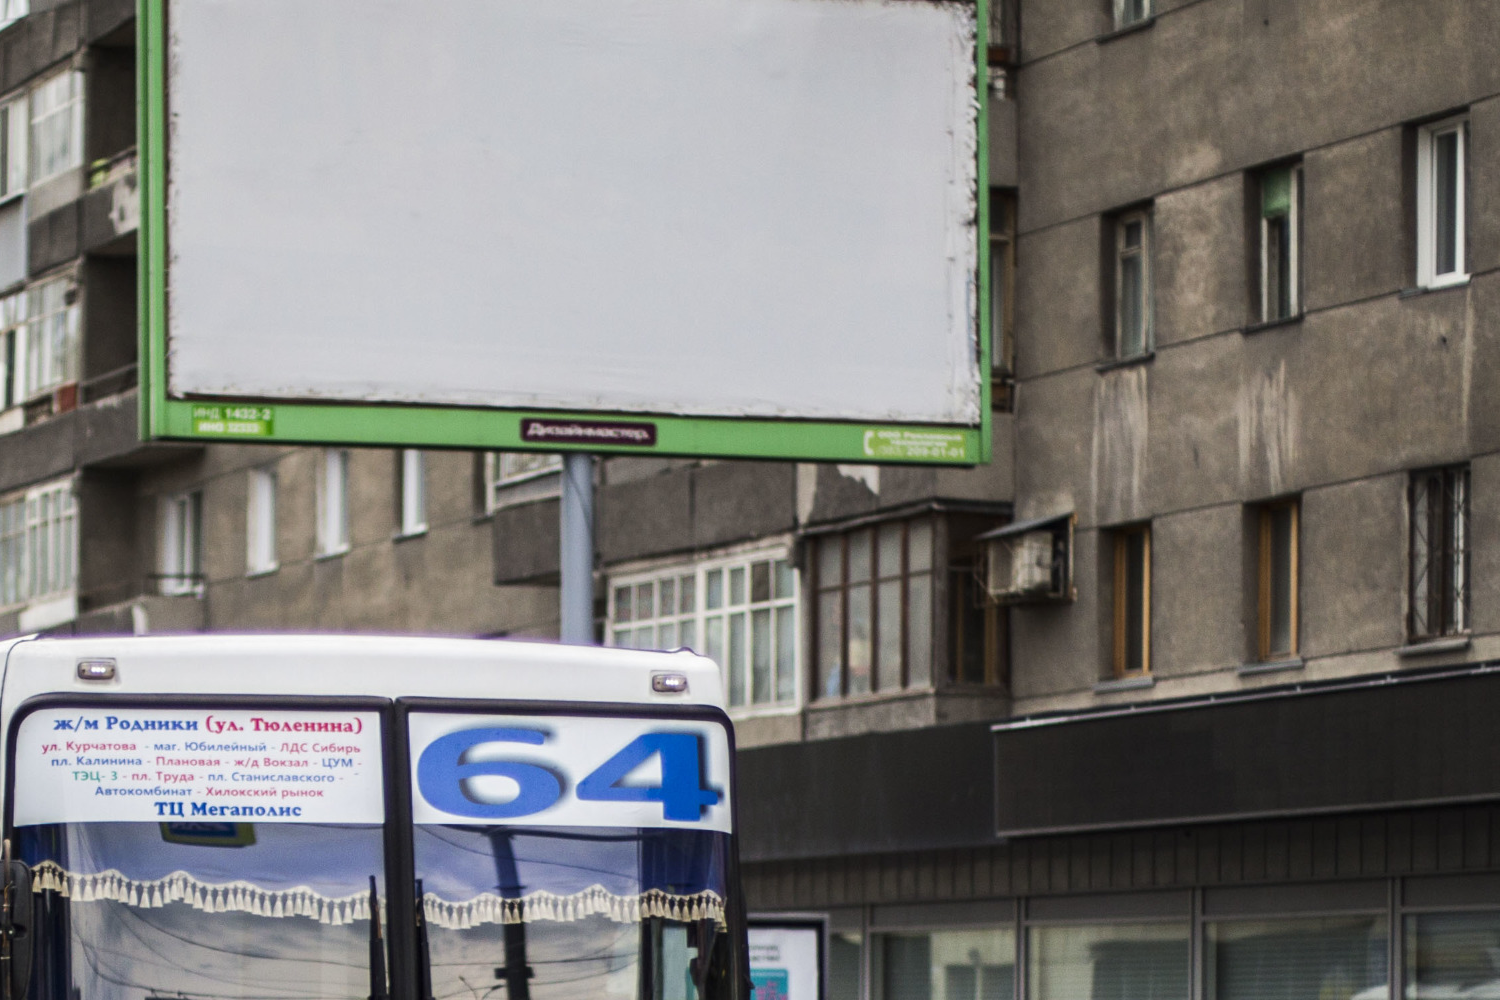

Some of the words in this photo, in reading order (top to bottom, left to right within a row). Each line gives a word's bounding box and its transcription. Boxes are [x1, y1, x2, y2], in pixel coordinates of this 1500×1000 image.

[52, 715, 100, 733] ж/м
[104, 715, 199, 733] Родники
[205, 714, 244, 735] (ул.
[249, 716, 363, 735] Тюленина)
[41, 743, 61, 755] ул.
[65, 740, 137, 754] Курчатова
[153, 743, 181, 752] маг.
[184, 741, 267, 752] Юбилейный
[279, 742, 309, 754] ЛДС
[311, 742, 361, 755] Сибирь
[50, 758, 72, 767] пл.
[75, 755, 143, 766] Калинина
[155, 756, 221, 767] Плановая
[234, 757, 260, 769] ж/д
[263, 757, 309, 768] Вокзал
[321, 757, 353, 770] ЦУМ
[131, 772, 152, 782] пл.
[155, 771, 195, 783] Труда
[207, 773, 228, 782] пл.
[231, 771, 335, 783] Станиславского
[416, 727, 720, 822] 64
[94, 785, 193, 797] Автокомбинат
[205, 786, 277, 798] Хилокский
[281, 789, 324, 800] рынок
[153, 801, 185, 818] ТЦ
[189, 801, 302, 817] Мегаполис
